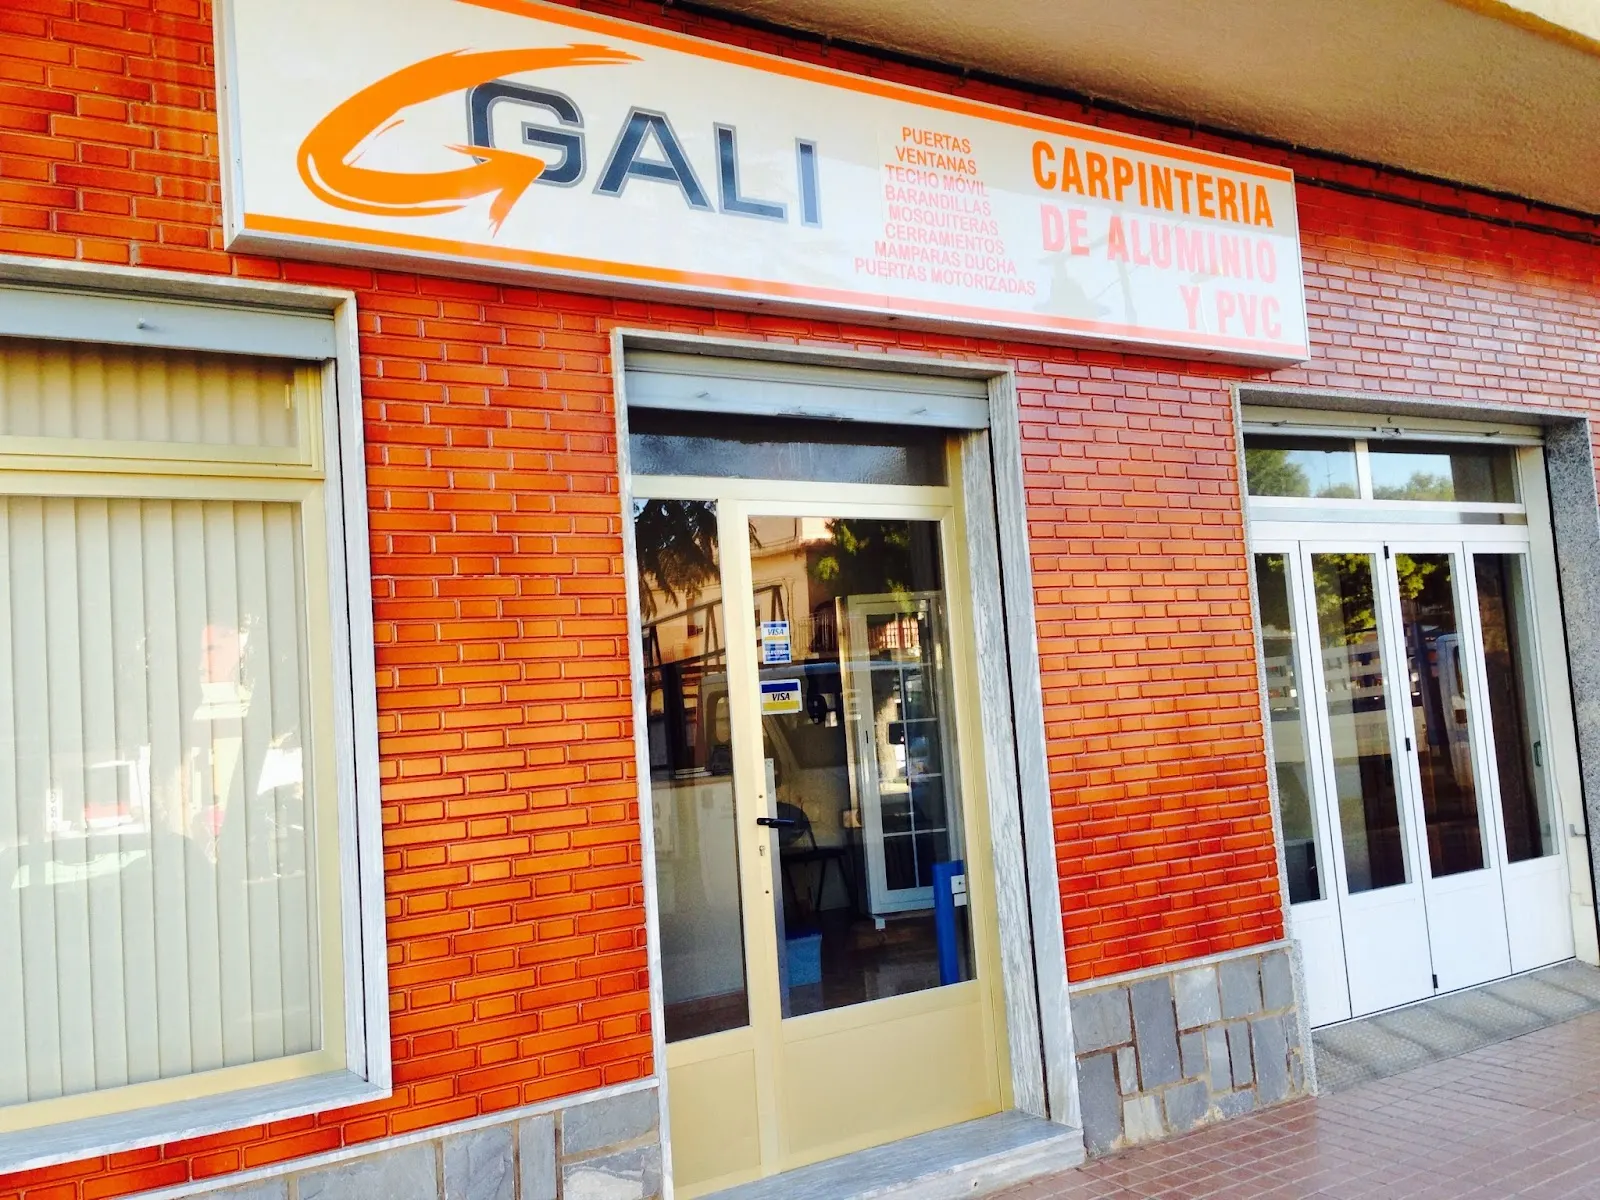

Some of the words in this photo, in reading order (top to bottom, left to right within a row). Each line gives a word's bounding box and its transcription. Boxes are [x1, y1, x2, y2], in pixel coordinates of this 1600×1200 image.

[466, 79, 823, 229] GALI
[902, 126, 972, 155] PUERTAS
[895, 146, 977, 176] VENTANAS
[885, 164, 939, 189] TECHO
[943, 173, 990, 198] MÓVIL
[1032, 140, 1275, 228] CARPINTERIA
[885, 185, 992, 216] BARANDILLAS
[888, 203, 999, 236] MOSQUITERAS
[885, 222, 1005, 256] CERRAMIENTOS
[1040, 204, 1091, 257] DE
[1107, 214, 1278, 284] ALUMINIO
[874, 240, 961, 269] MAMPARAS
[965, 252, 1017, 276] DUCHA
[854, 257, 927, 282] PUERTAS
[931, 267, 1036, 296] MOTORIZADAS
[1179, 284, 1201, 330] Y
[1216, 289, 1283, 339] PVC
[772, 692, 790, 701] VISA
